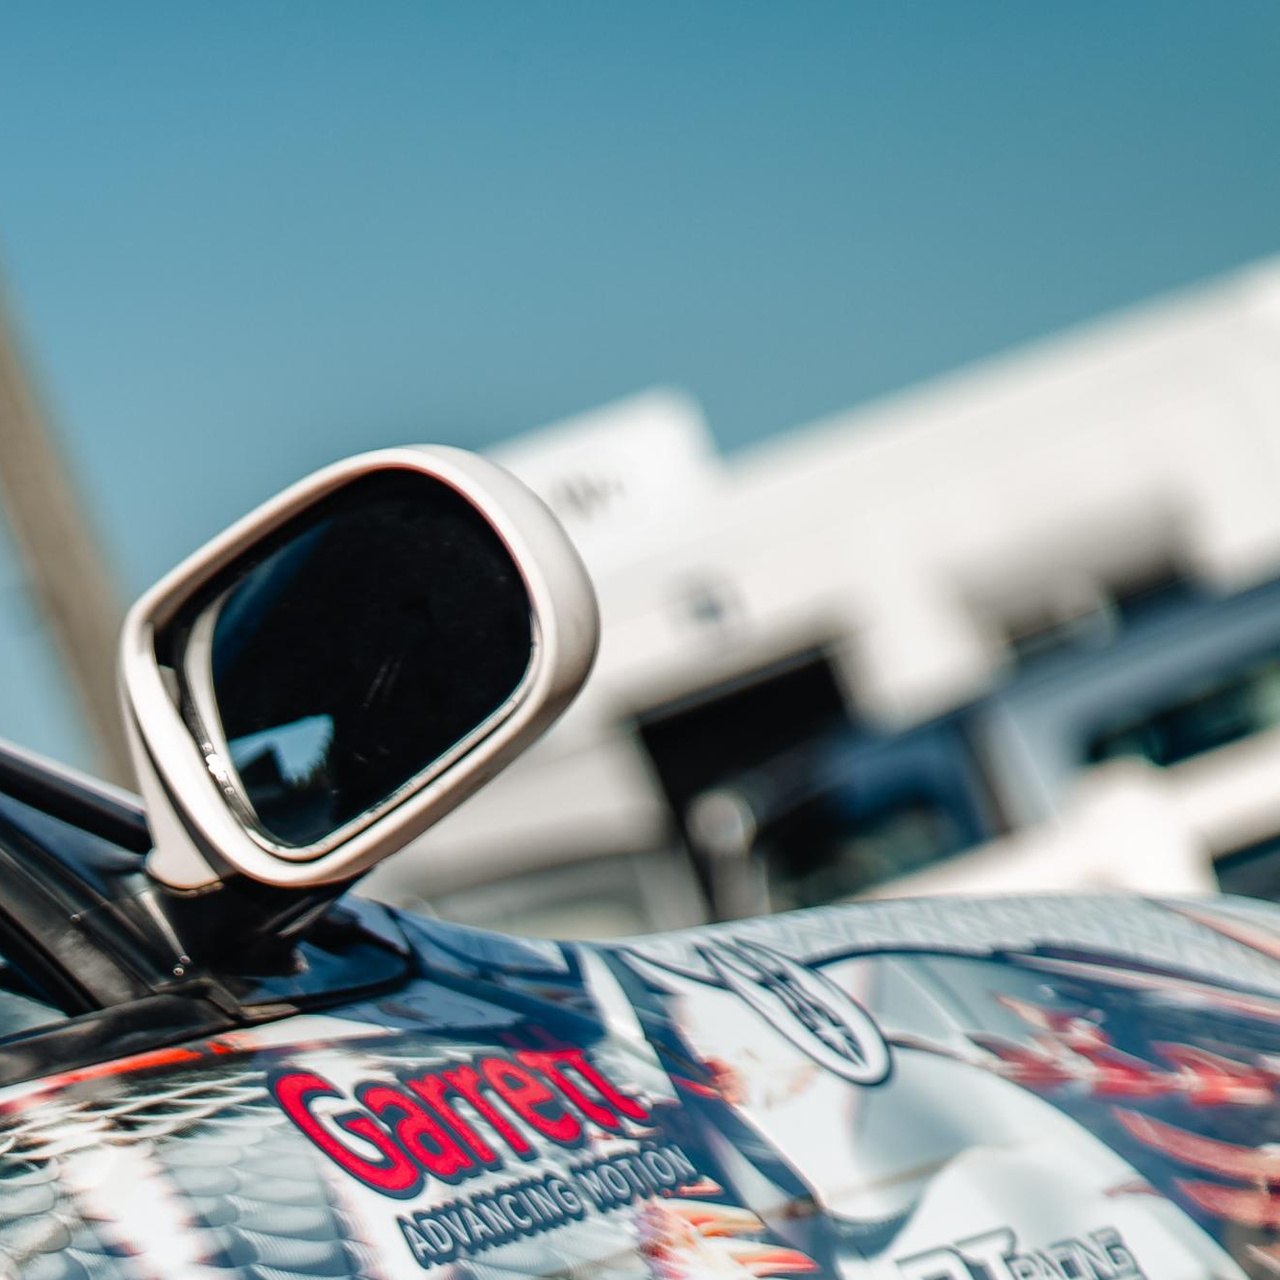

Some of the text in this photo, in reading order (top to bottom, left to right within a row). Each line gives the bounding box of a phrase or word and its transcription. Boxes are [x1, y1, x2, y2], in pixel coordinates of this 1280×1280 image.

[273, 1026, 650, 1192] Garrett
[399, 1142, 699, 1266] ADVANCING MOTION
